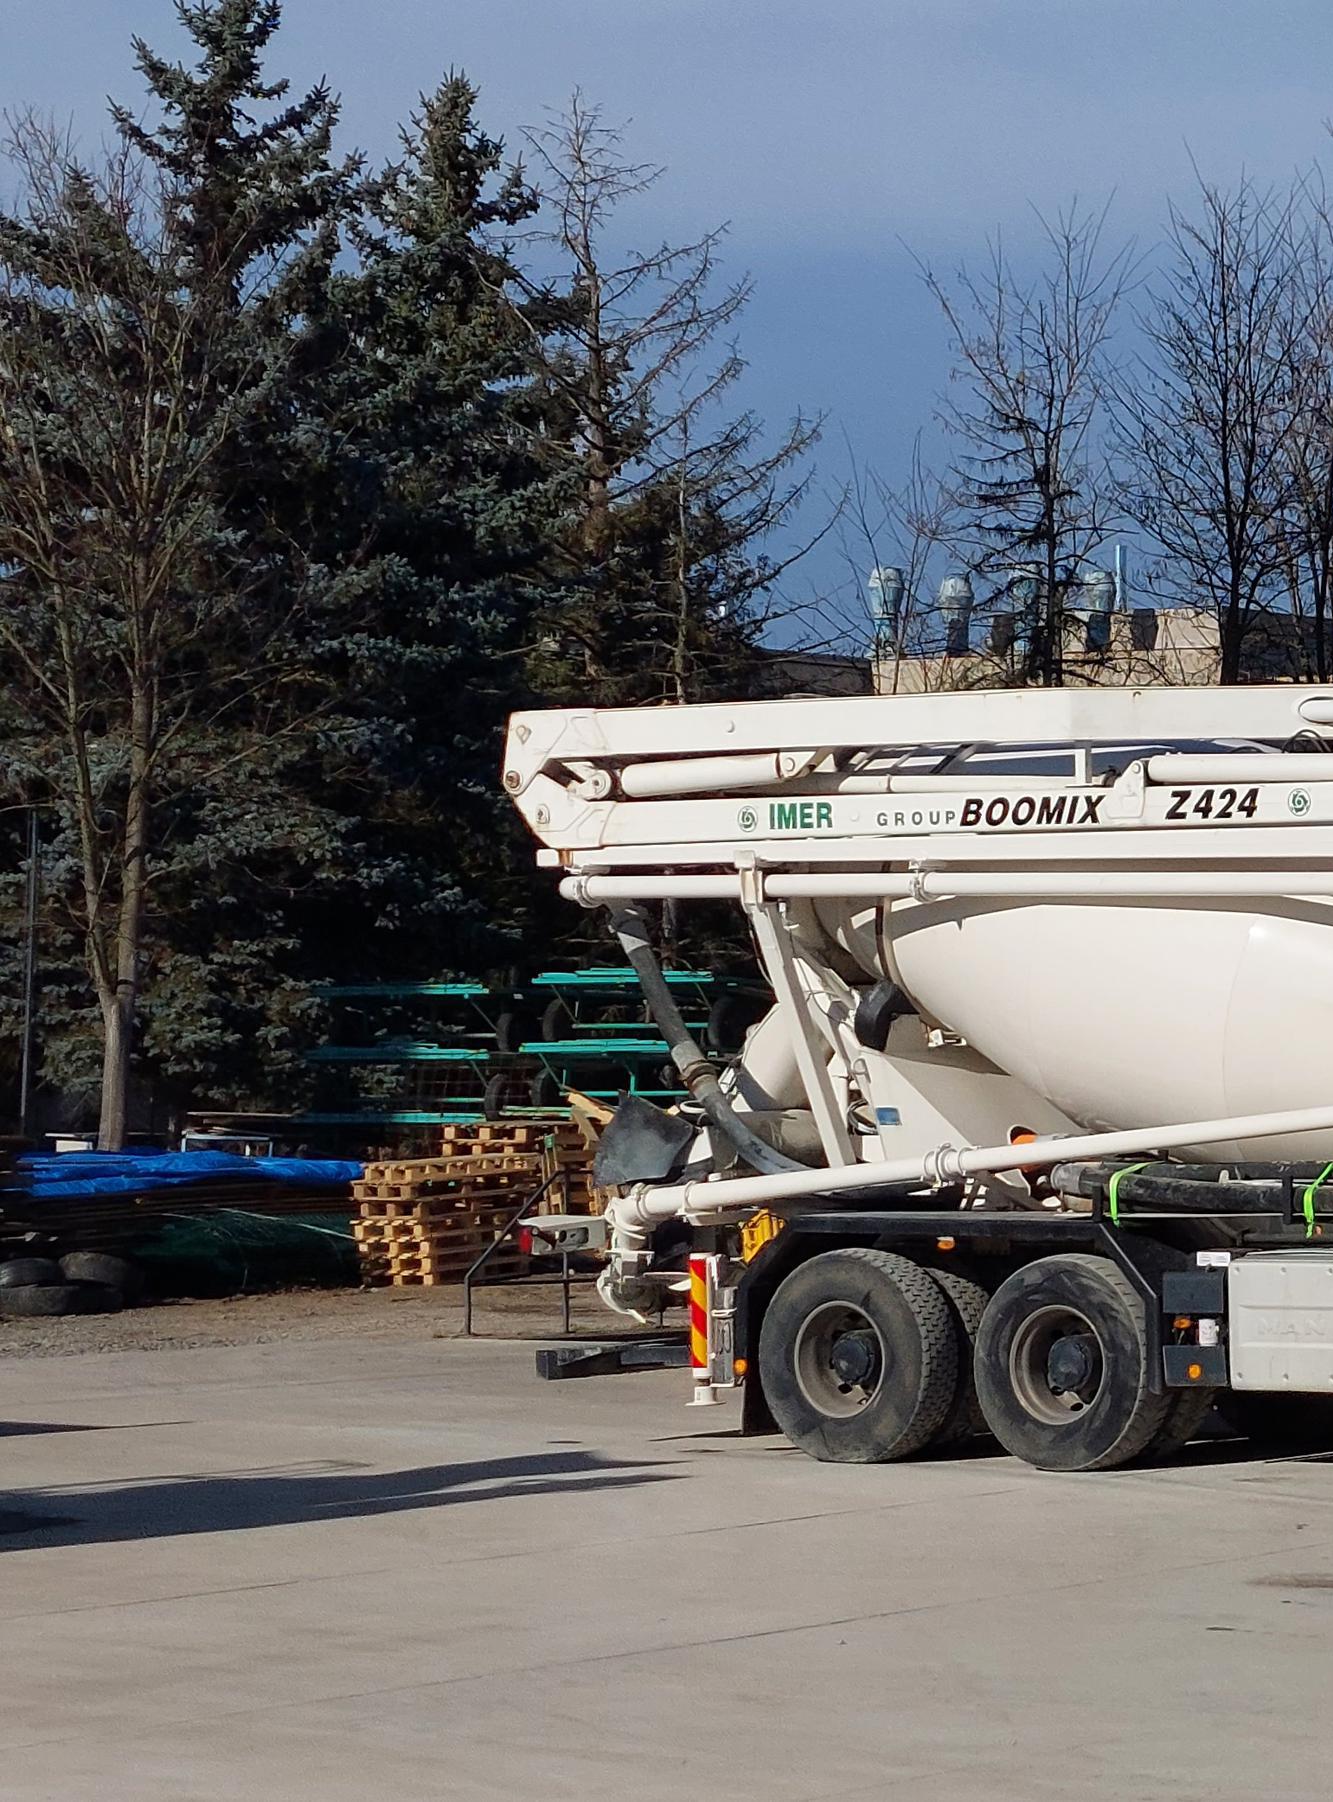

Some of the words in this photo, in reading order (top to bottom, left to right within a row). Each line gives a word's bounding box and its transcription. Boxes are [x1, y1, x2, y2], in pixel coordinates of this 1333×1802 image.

[769, 802, 833, 830] IMER
[876, 811, 956, 827] GROUP
[960, 795, 1105, 827] BOOMIX
[1165, 788, 1258, 820] Z424
